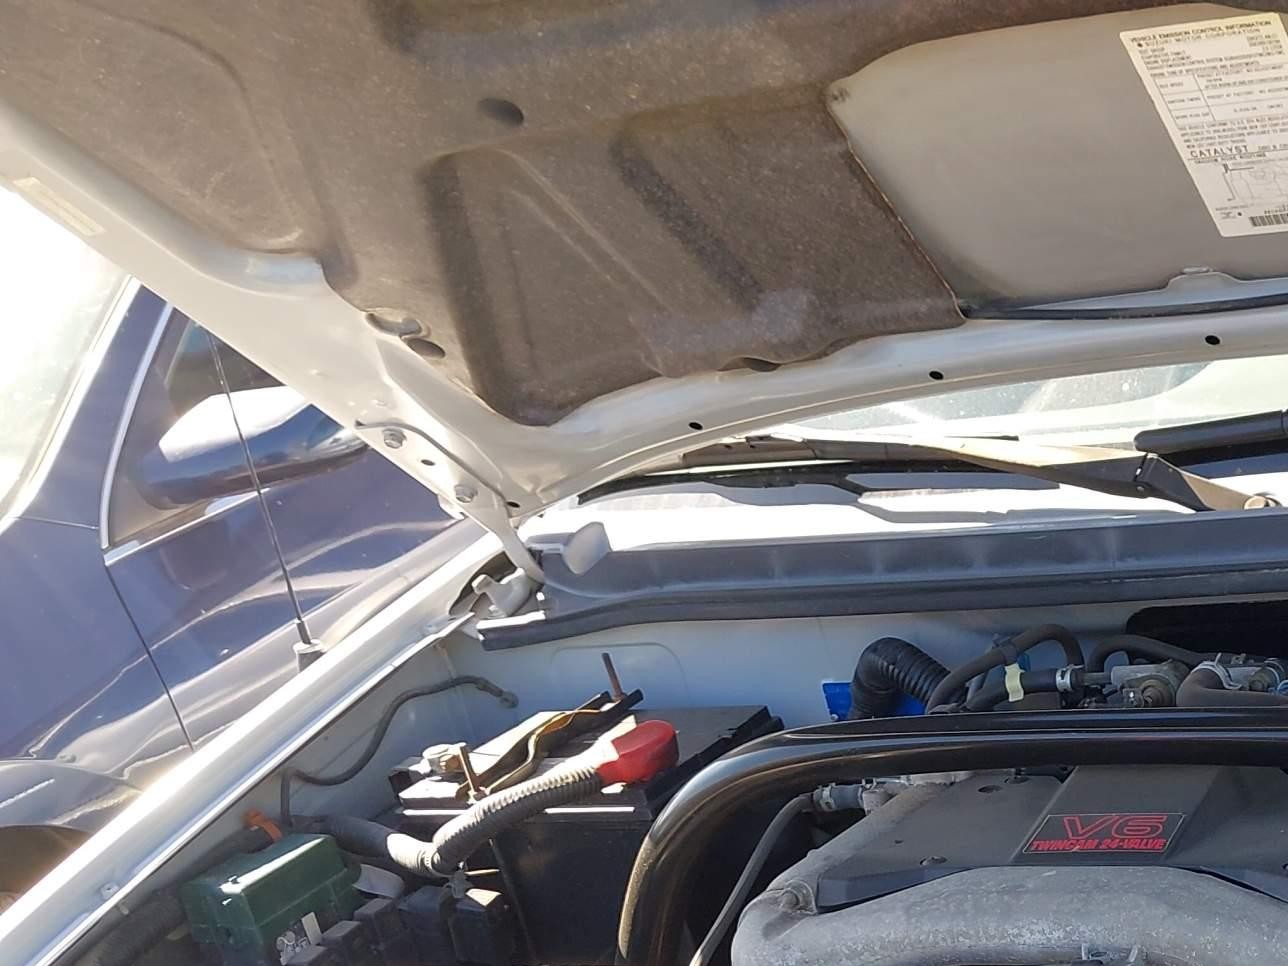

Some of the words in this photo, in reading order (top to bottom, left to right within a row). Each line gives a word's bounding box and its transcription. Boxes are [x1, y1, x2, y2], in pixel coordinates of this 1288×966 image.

[1190, 145, 1250, 159] CATALYST
[1063, 815, 1168, 840] V6
[1031, 839, 1098, 851] TWINCAM
[1100, 838, 1167, 850] 24-VALVE
